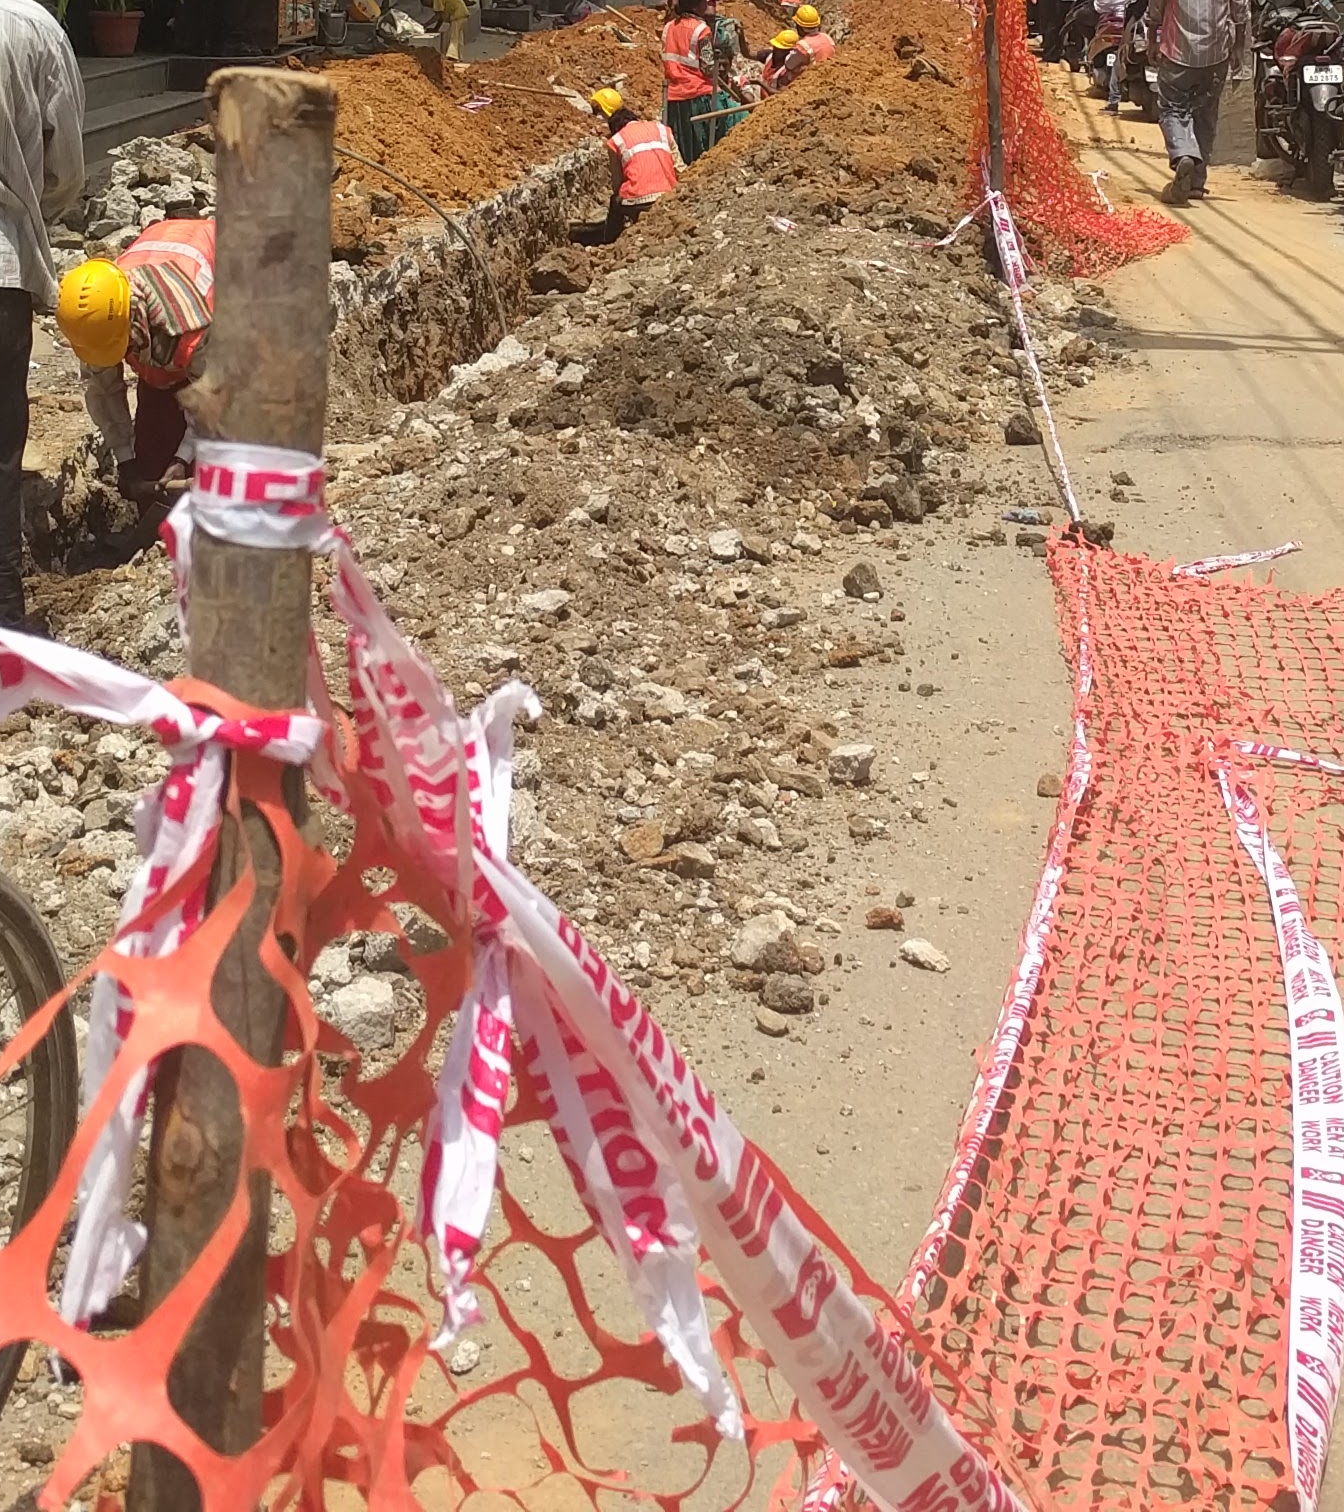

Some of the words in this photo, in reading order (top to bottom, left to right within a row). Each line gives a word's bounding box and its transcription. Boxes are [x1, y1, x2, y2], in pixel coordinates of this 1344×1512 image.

[1298, 1058, 1320, 1106] DANGER
[1320, 1051, 1344, 1105] CAUTION
[1301, 1120, 1322, 1153] WORK
[1300, 1218, 1325, 1276] DANGER
[1300, 1295, 1323, 1338] WORK
[816, 1349, 870, 1412] AT
[844, 1388, 915, 1470] MEN
